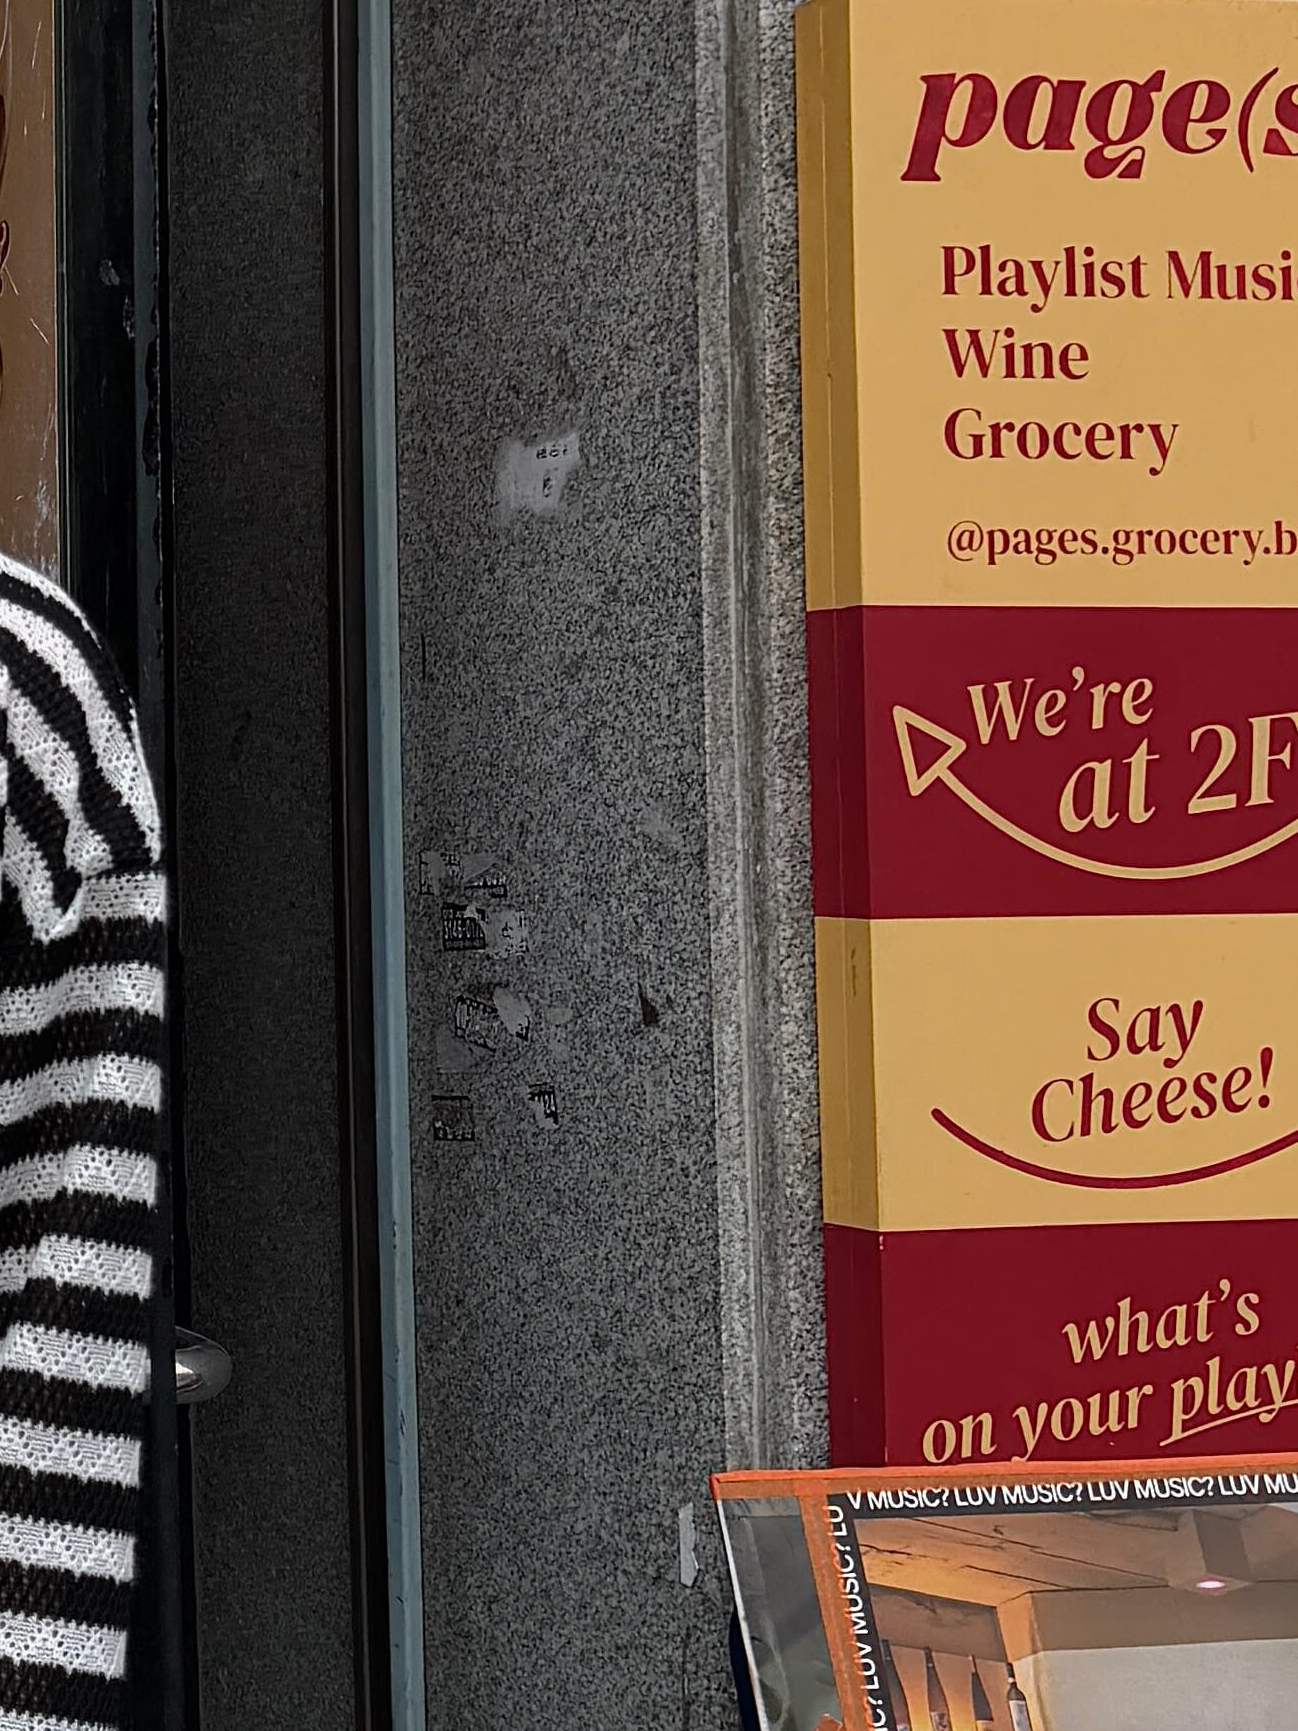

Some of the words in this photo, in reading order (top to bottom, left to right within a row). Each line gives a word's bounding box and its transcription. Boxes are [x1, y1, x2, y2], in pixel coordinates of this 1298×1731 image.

[940, 244, 1151, 314] Playlist
[1166, 250, 1298, 302] Musi
[942, 327, 1090, 381] Wine
[943, 407, 1180, 476] Grocery
[1058, 736, 1161, 833] at
[1187, 711, 1298, 815] 2F
[1086, 997, 1204, 1068] Say
[1030, 1047, 1274, 1143] Cheese!
[922, 1415, 998, 1463] on
[1013, 1382, 1155, 1462] your
[1168, 1356, 1297, 1443] play
